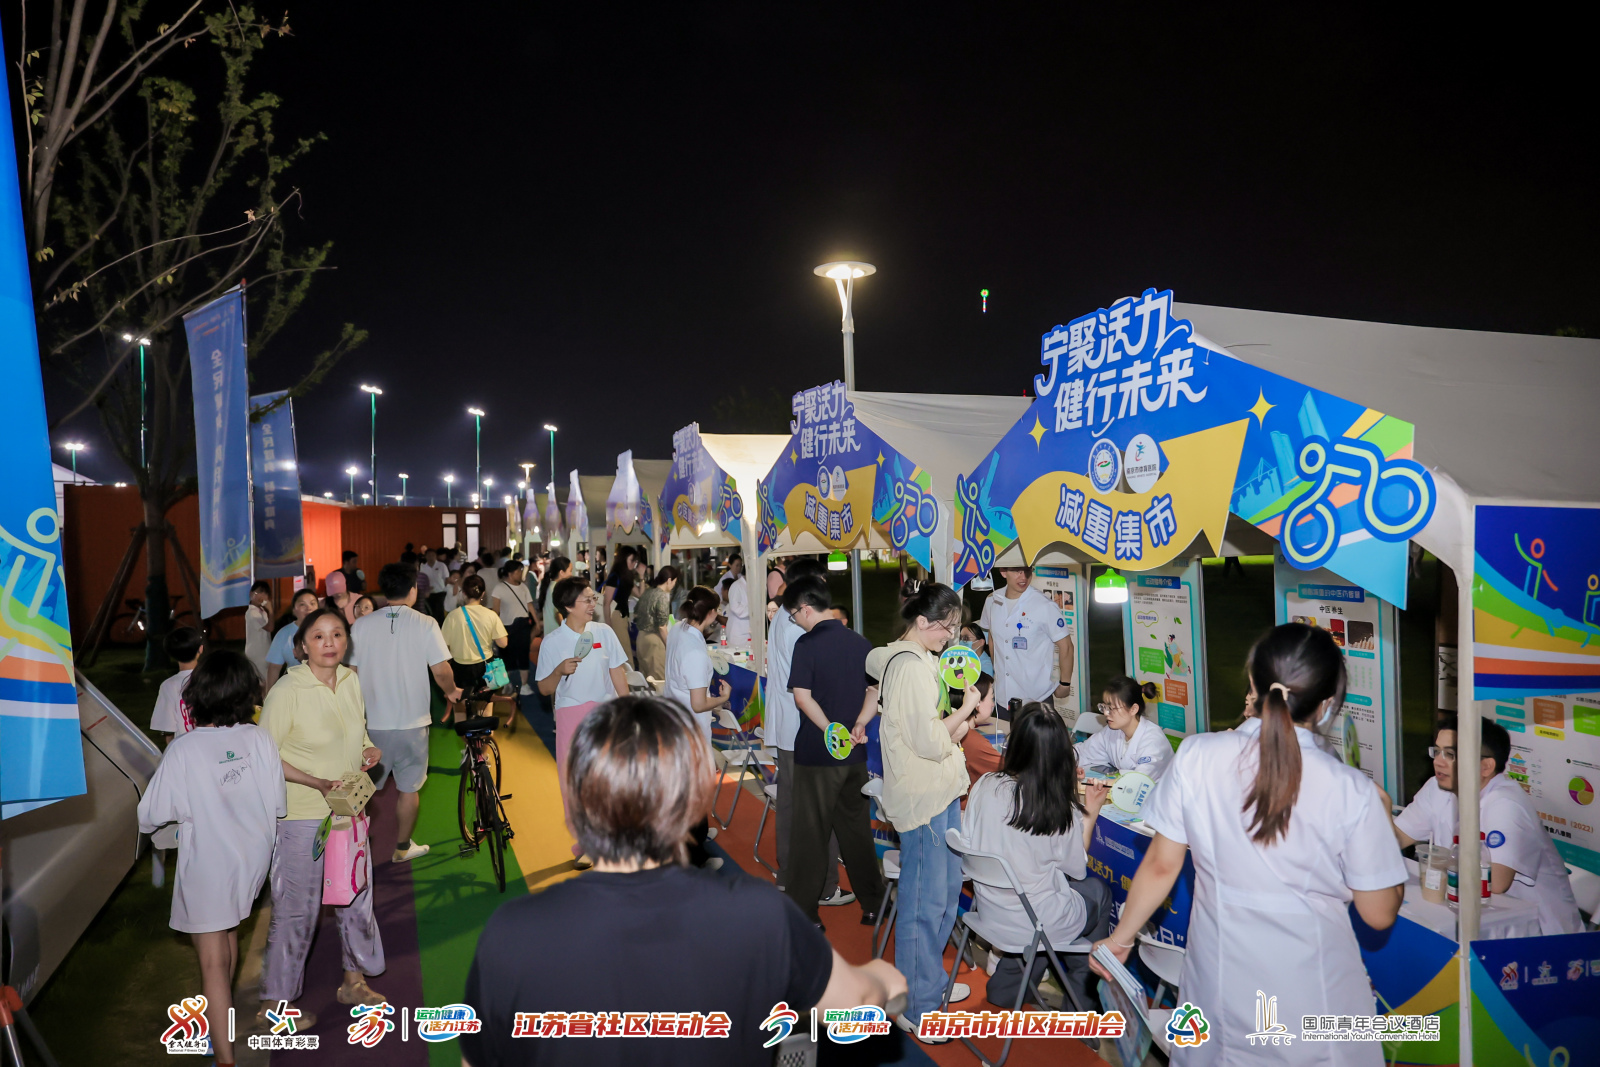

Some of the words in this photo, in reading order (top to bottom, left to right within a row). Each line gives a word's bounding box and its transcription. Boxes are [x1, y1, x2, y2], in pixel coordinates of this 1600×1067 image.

[1036, 294, 1191, 396] 宁聚活力
[791, 382, 855, 434] 宁聚活力
[1054, 348, 1208, 437] 健行未来
[800, 418, 861, 464] 健行未来
[805, 492, 853, 540] 减重集市
[1058, 487, 1176, 558] 减重集市
